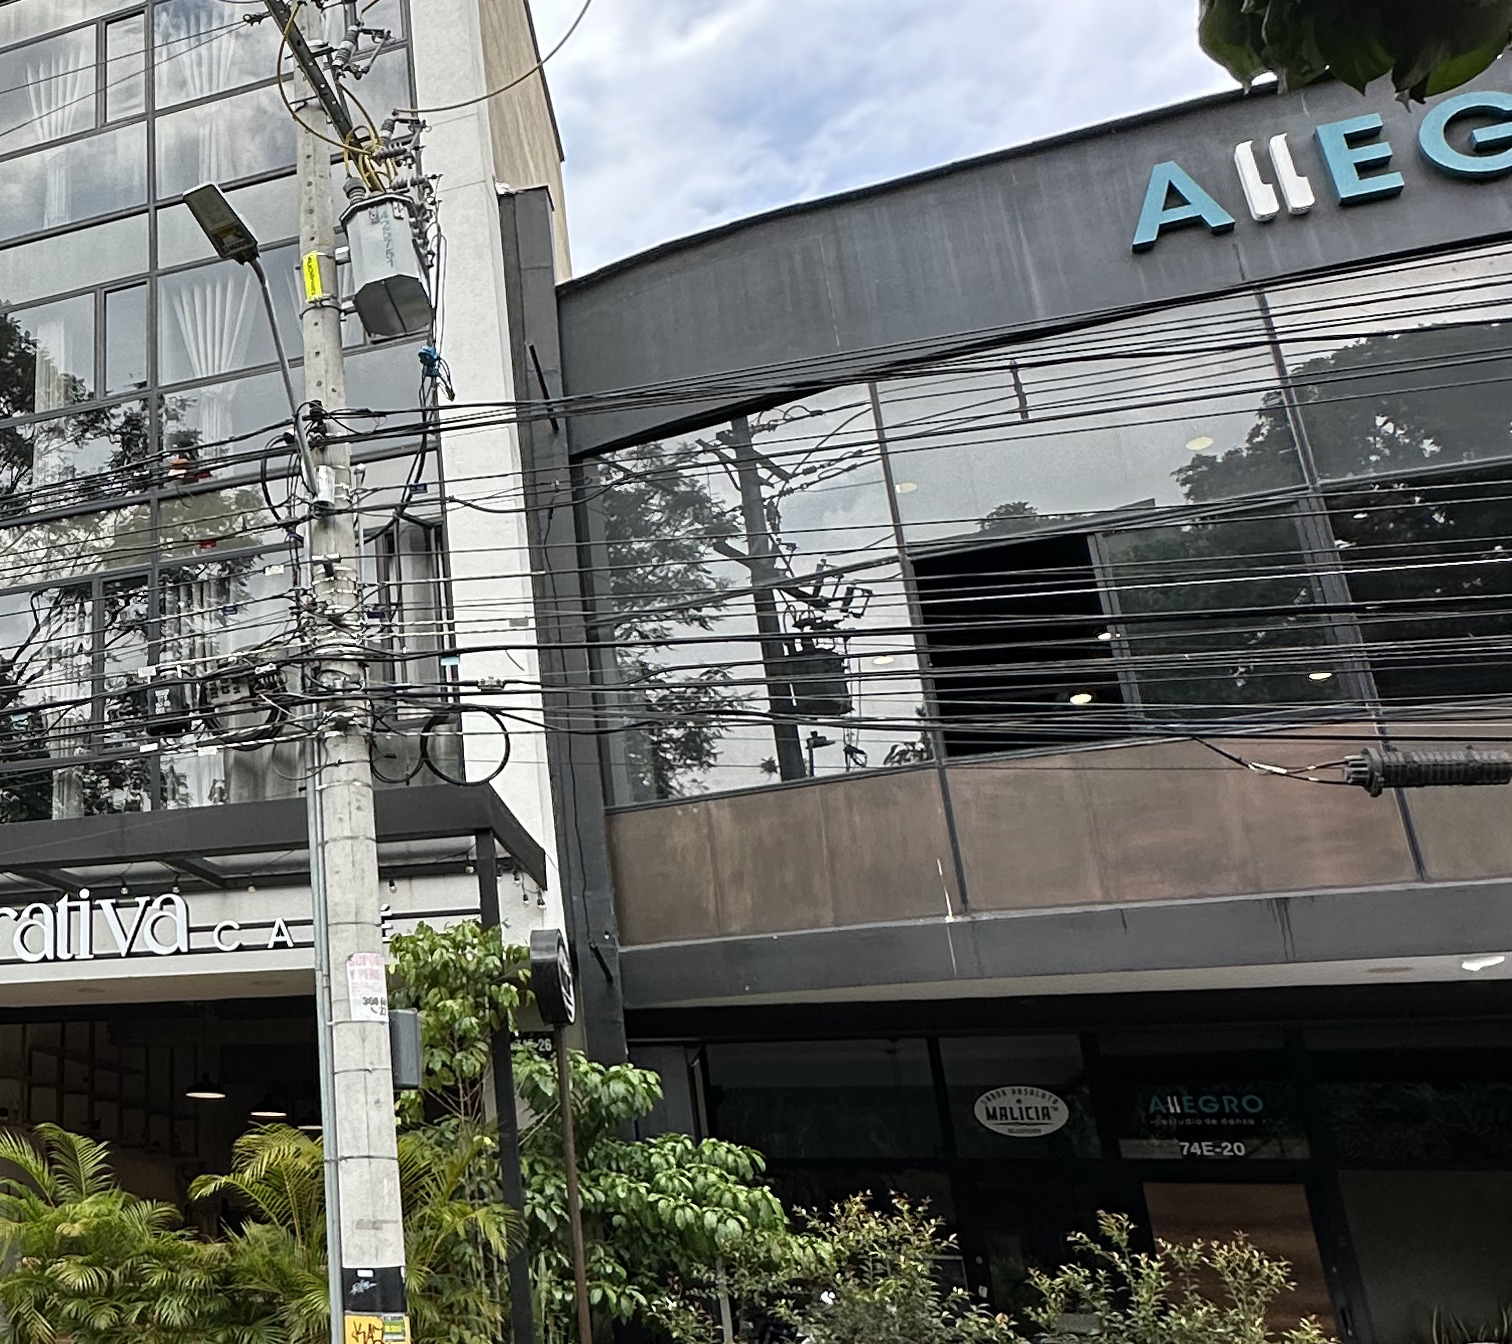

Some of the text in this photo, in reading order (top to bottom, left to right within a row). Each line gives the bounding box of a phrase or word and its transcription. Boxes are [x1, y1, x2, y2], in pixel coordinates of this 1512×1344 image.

[212, 902, 392, 952] CAÉ
[985, 1105, 1053, 1121] MALICIA
[1179, 1141, 1246, 1156] 74E-20
